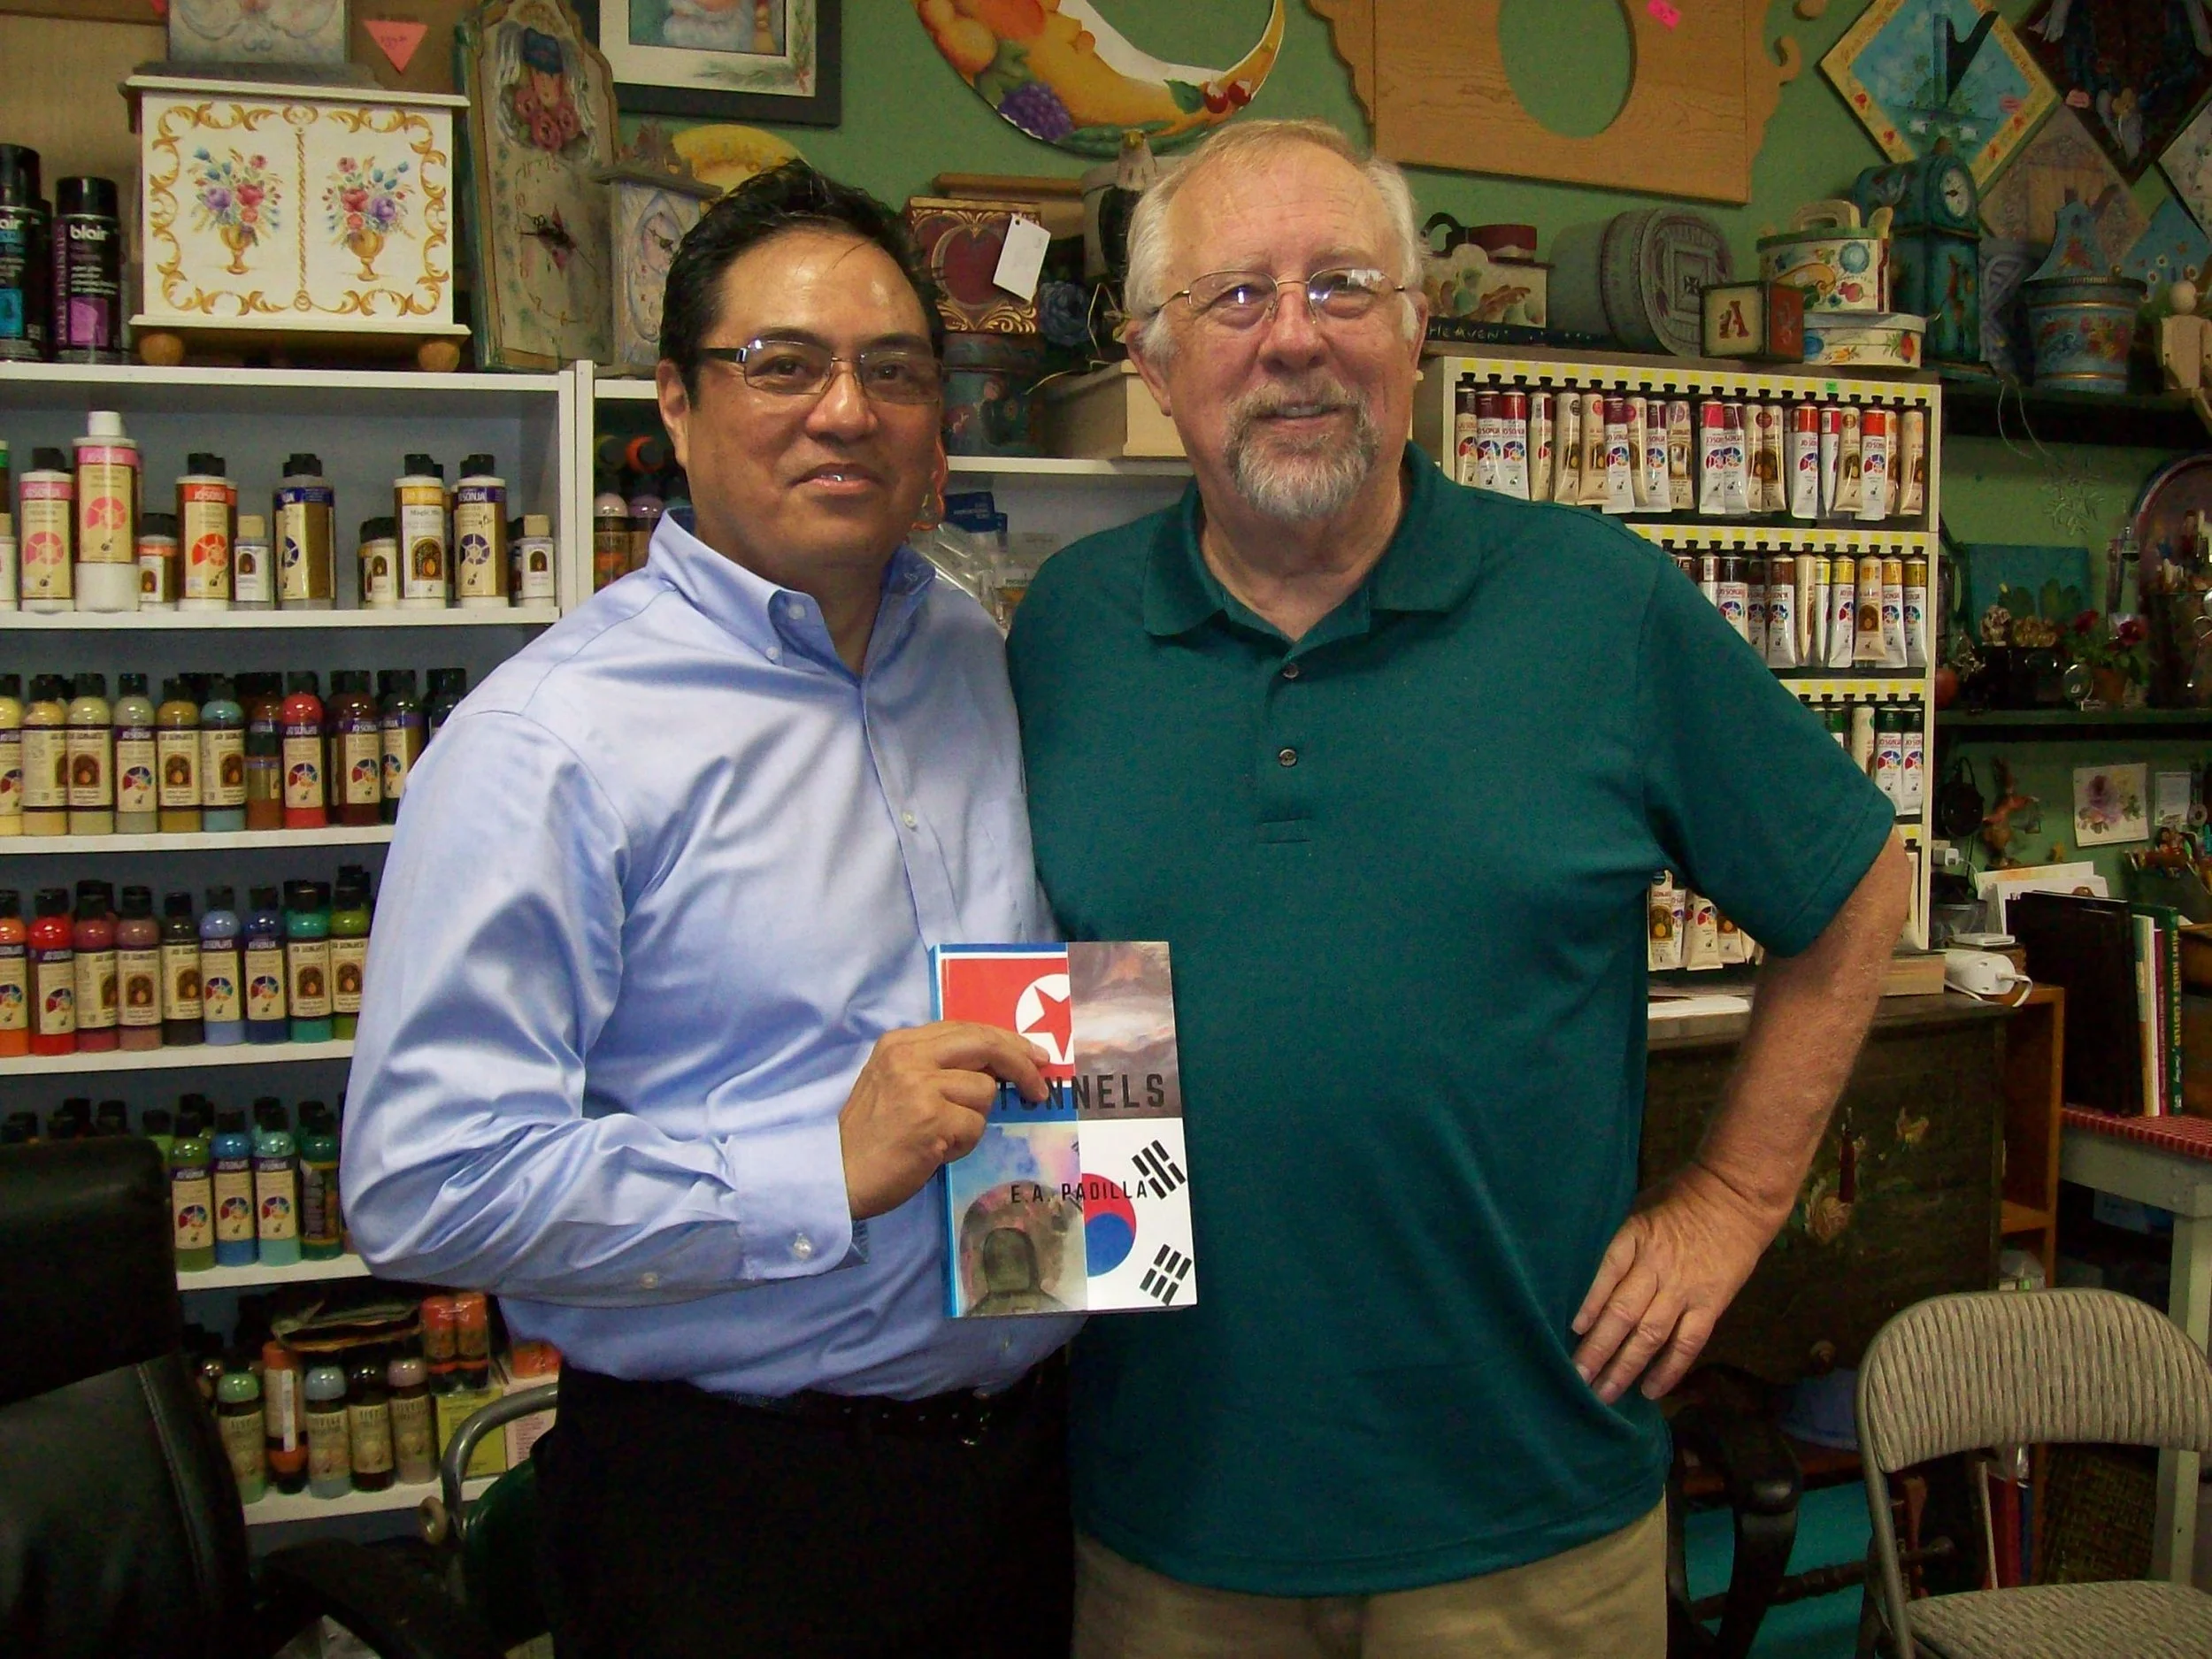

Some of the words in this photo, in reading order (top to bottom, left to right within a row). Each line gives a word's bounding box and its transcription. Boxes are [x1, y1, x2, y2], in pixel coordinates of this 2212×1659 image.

[0, 215, 24, 230] air
[70, 224, 110, 241] blair
[1062, 1180, 1148, 1201] PADILLA
